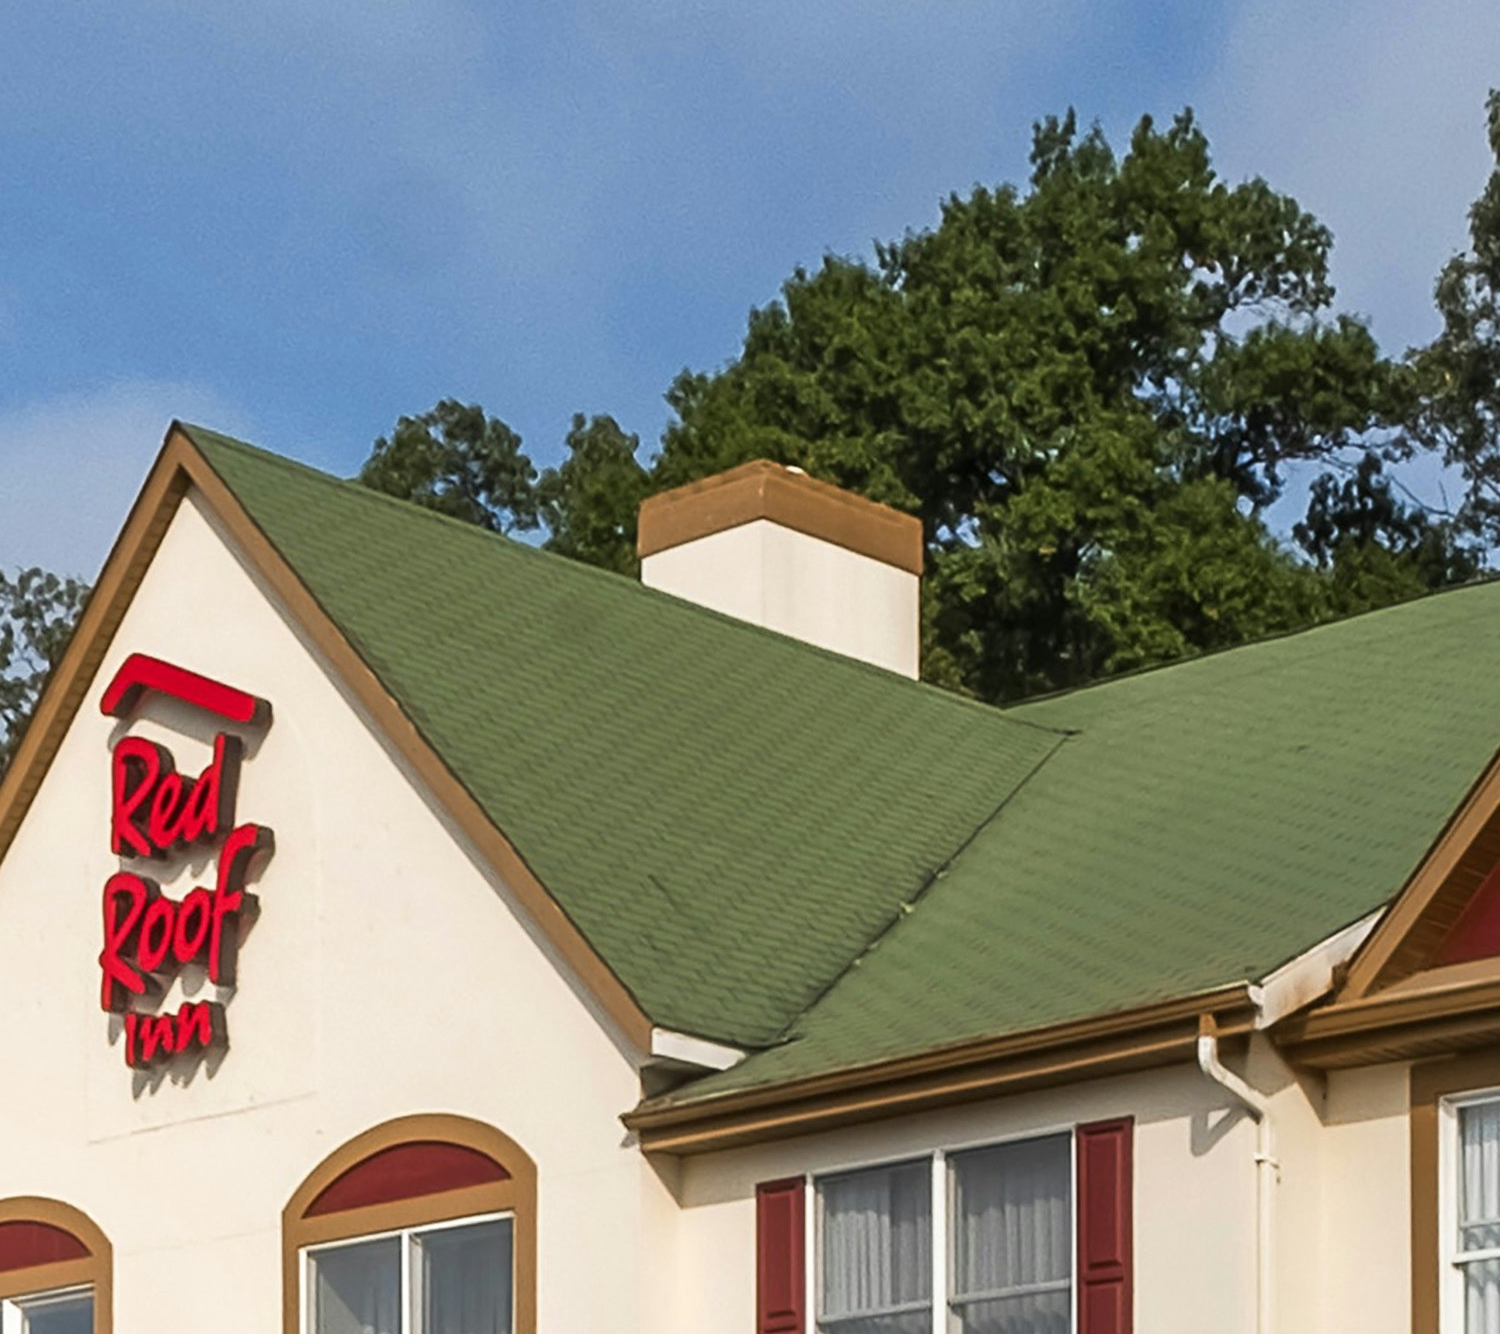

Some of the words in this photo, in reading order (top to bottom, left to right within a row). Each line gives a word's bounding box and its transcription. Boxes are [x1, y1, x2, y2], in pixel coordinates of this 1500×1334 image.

[112, 733, 225, 857] Red
[101, 824, 258, 1012] Roof
[125, 1001, 212, 1067] Inn
